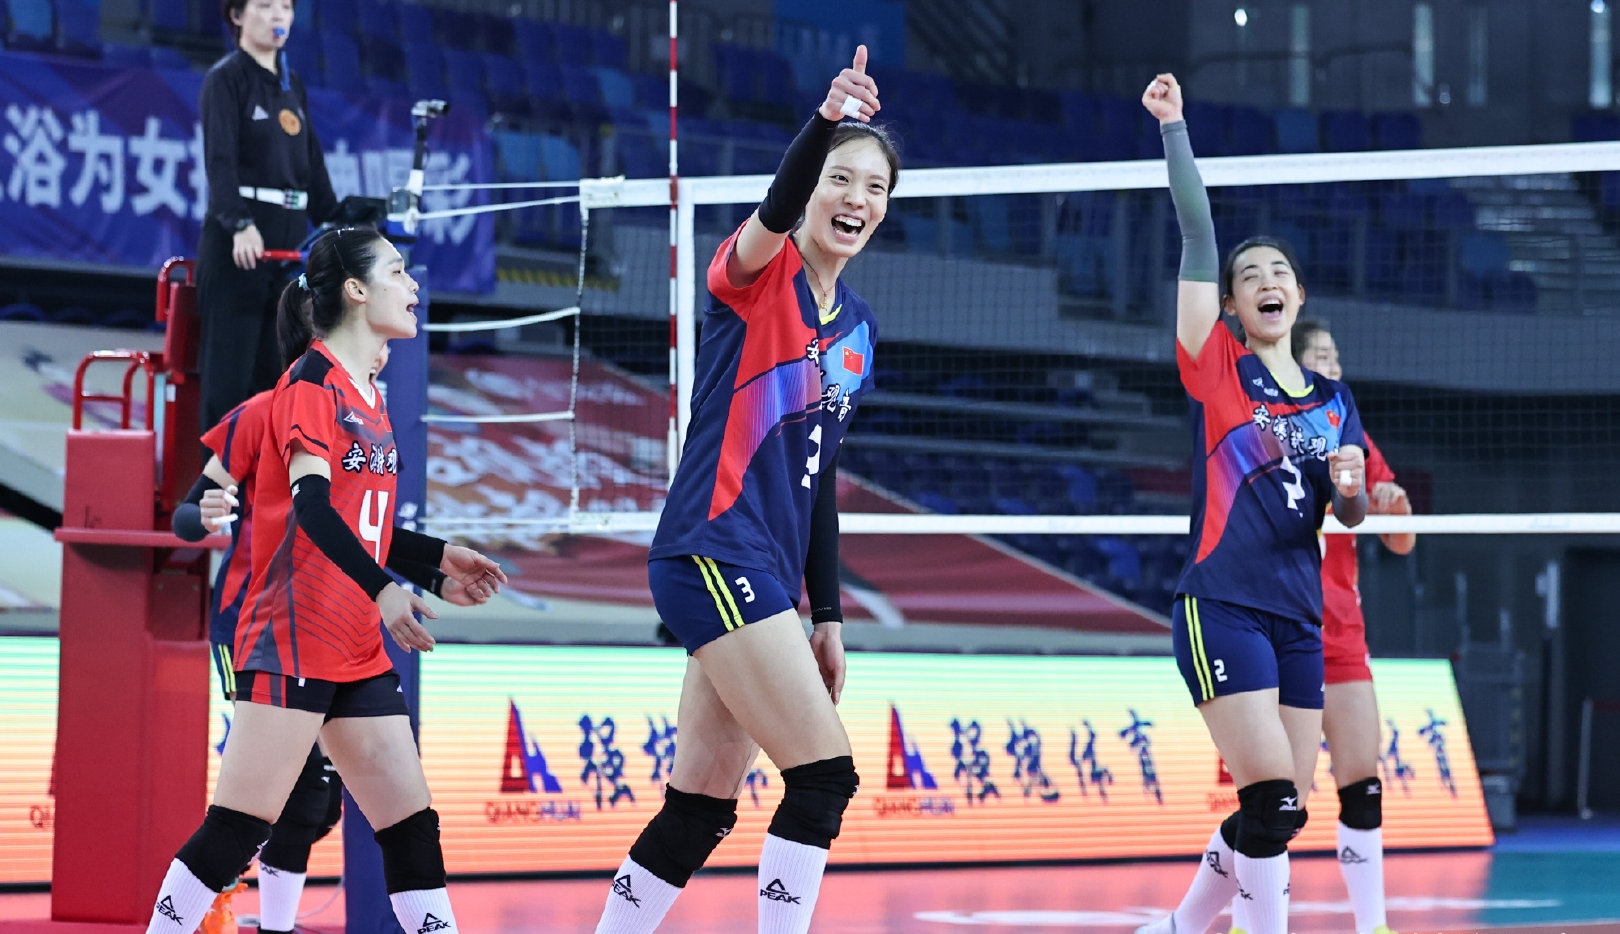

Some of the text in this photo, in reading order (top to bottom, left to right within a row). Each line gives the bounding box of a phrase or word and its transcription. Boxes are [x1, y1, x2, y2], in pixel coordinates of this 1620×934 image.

[359, 489, 389, 563] 4
[735, 576, 755, 603] 3
[1213, 659, 1228, 682] 2
[759, 889, 801, 905] PEAK
[417, 921, 451, 934] PEAK
